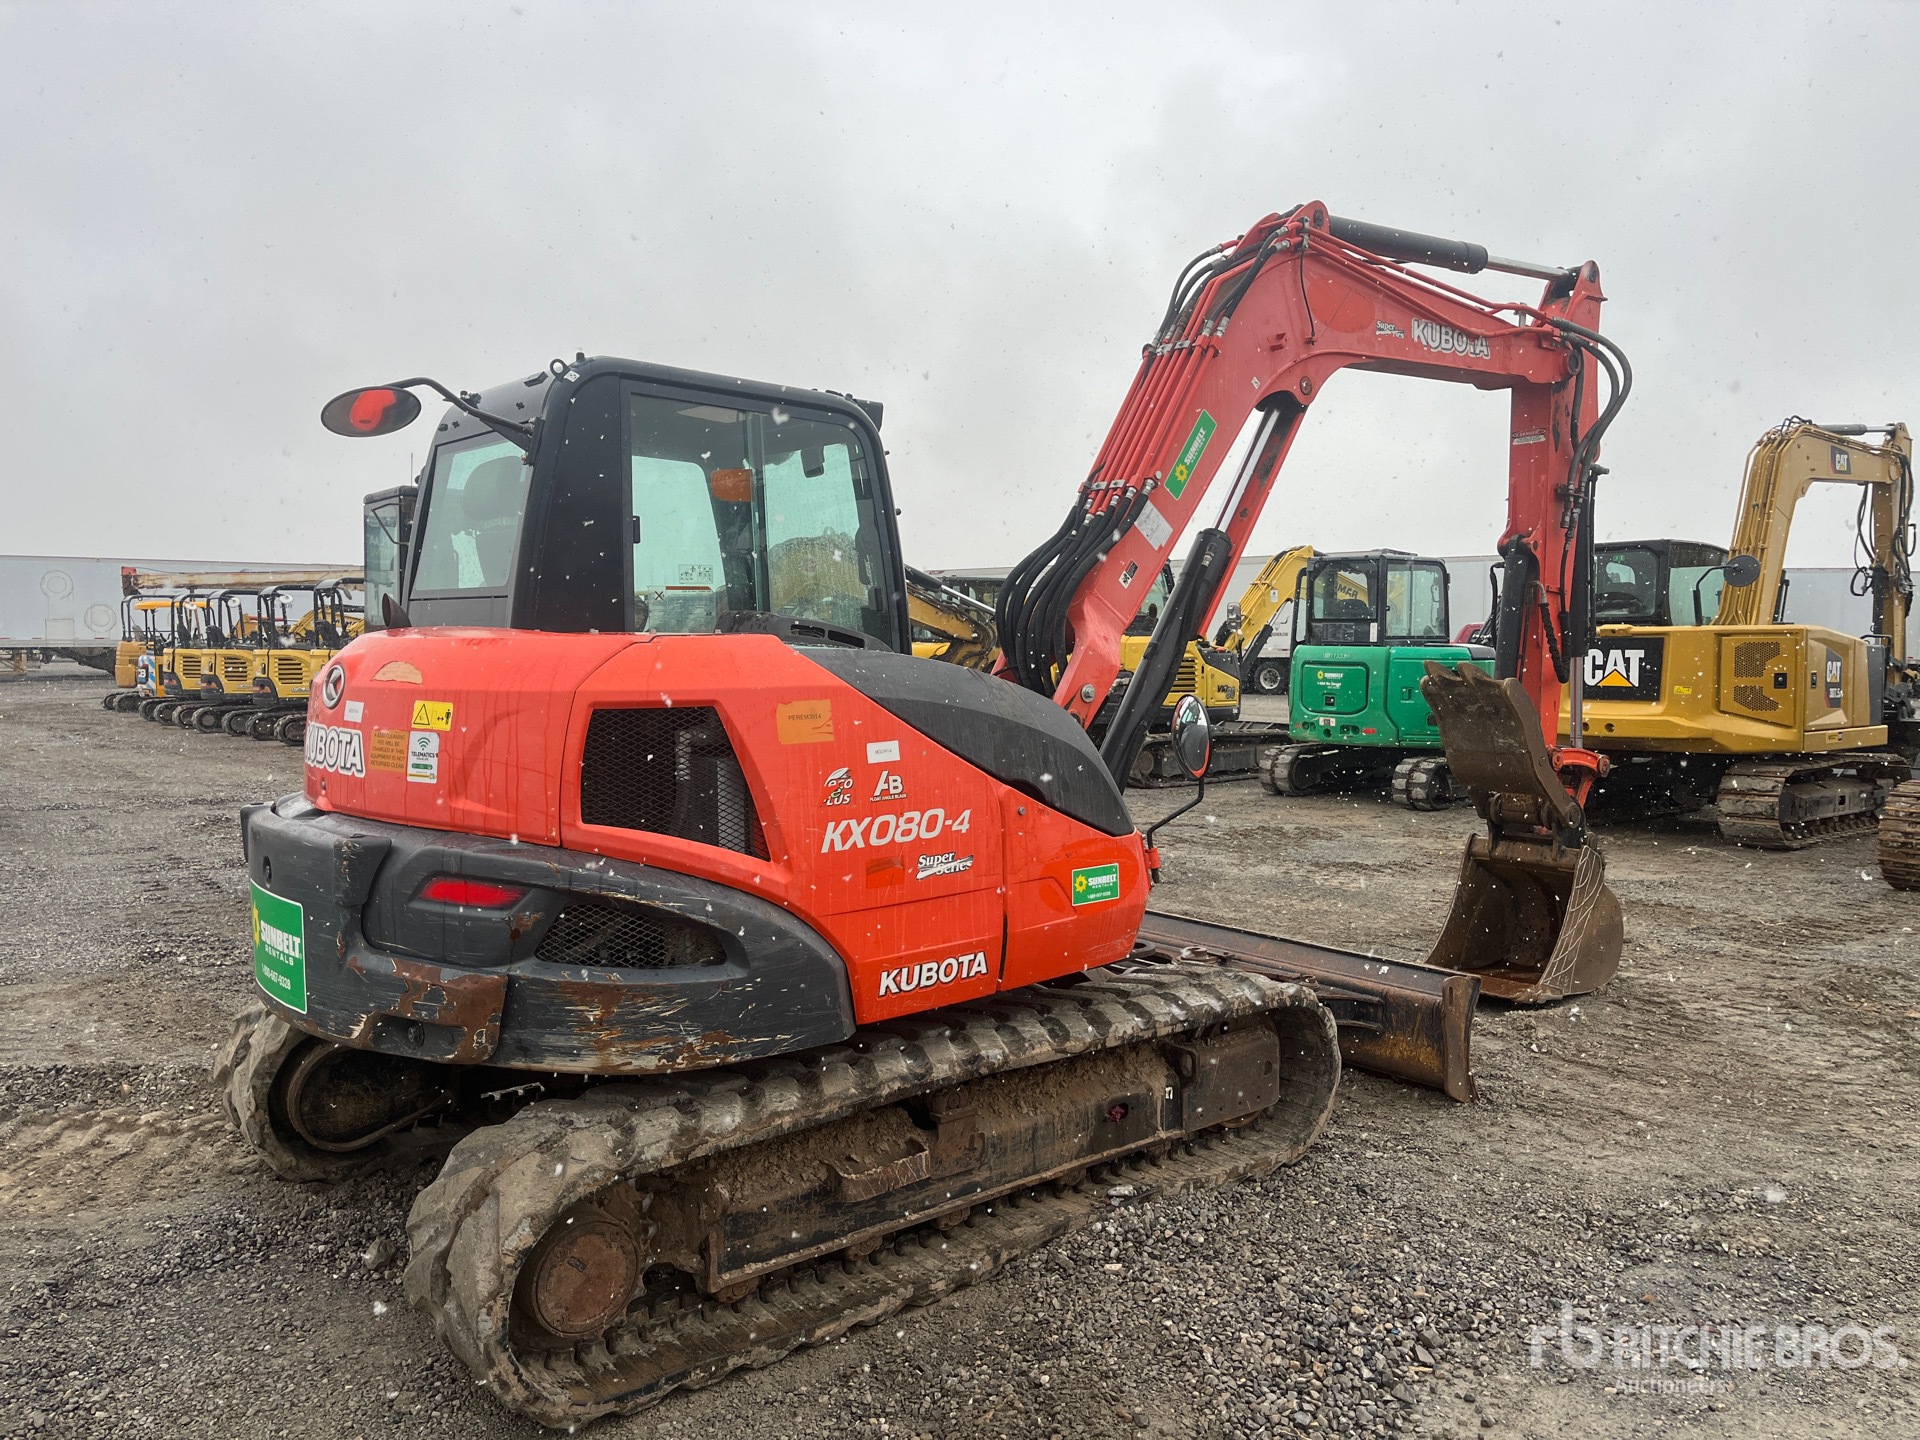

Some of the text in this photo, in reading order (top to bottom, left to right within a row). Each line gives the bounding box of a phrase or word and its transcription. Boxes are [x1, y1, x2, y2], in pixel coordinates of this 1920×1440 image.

[1376, 320, 1395, 331] Super
[1184, 427, 1206, 465] SUNBELT
[1835, 453, 1848, 471] CAT
[1337, 583, 1358, 599] MAR
[1584, 649, 1645, 687] CAT
[1826, 661, 1841, 683] CAT
[305, 721, 366, 778] KUBOTA
[873, 770, 904, 797] AB
[823, 793, 852, 806] LUS
[821, 807, 972, 853] KX080-4
[918, 851, 955, 867] Super
[1087, 874, 1117, 887] SUNBELT
[261, 920, 301, 959] SUNBELT
[265, 944, 294, 966] RENTALS
[878, 952, 988, 997] KUBOTA
